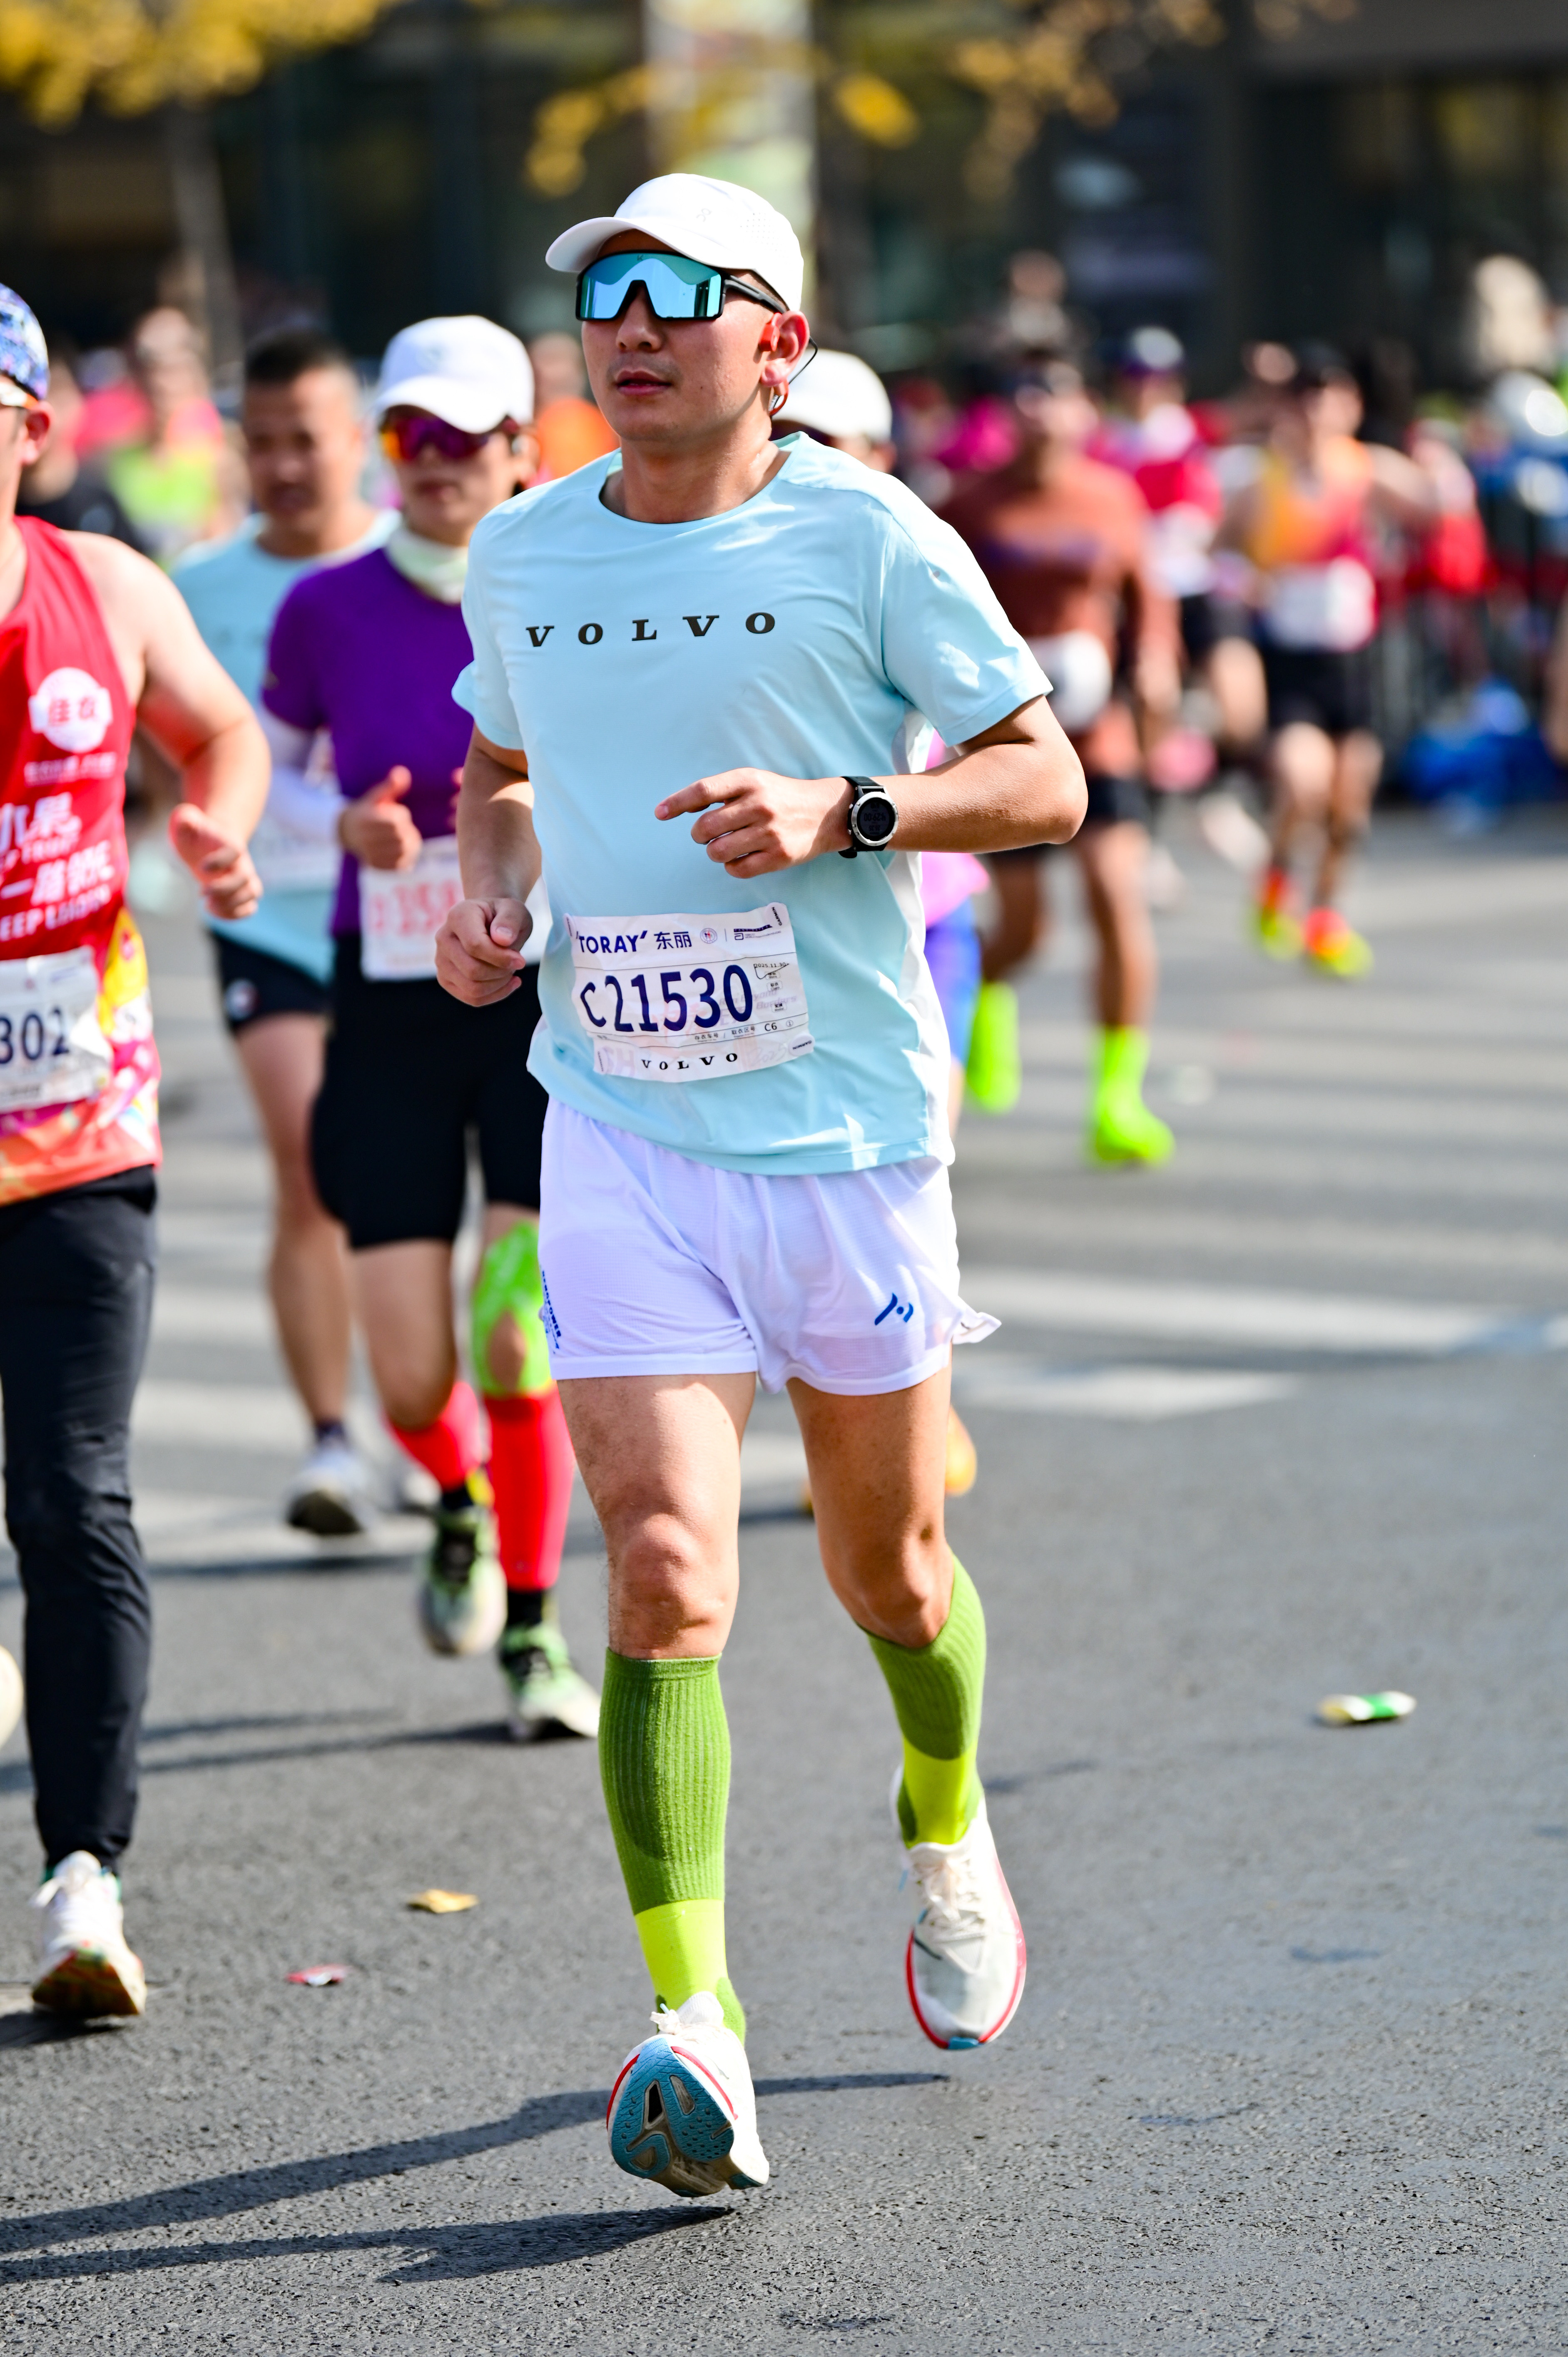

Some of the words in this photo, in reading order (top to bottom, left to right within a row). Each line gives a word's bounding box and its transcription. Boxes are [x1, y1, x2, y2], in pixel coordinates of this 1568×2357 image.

[526, 612, 775, 647] VOLVO
[654, 932, 692, 949] 东丽
[580, 965, 753, 1032] C21530
[764, 1023, 777, 1031] C6
[641, 1053, 737, 1070] VOLVO
